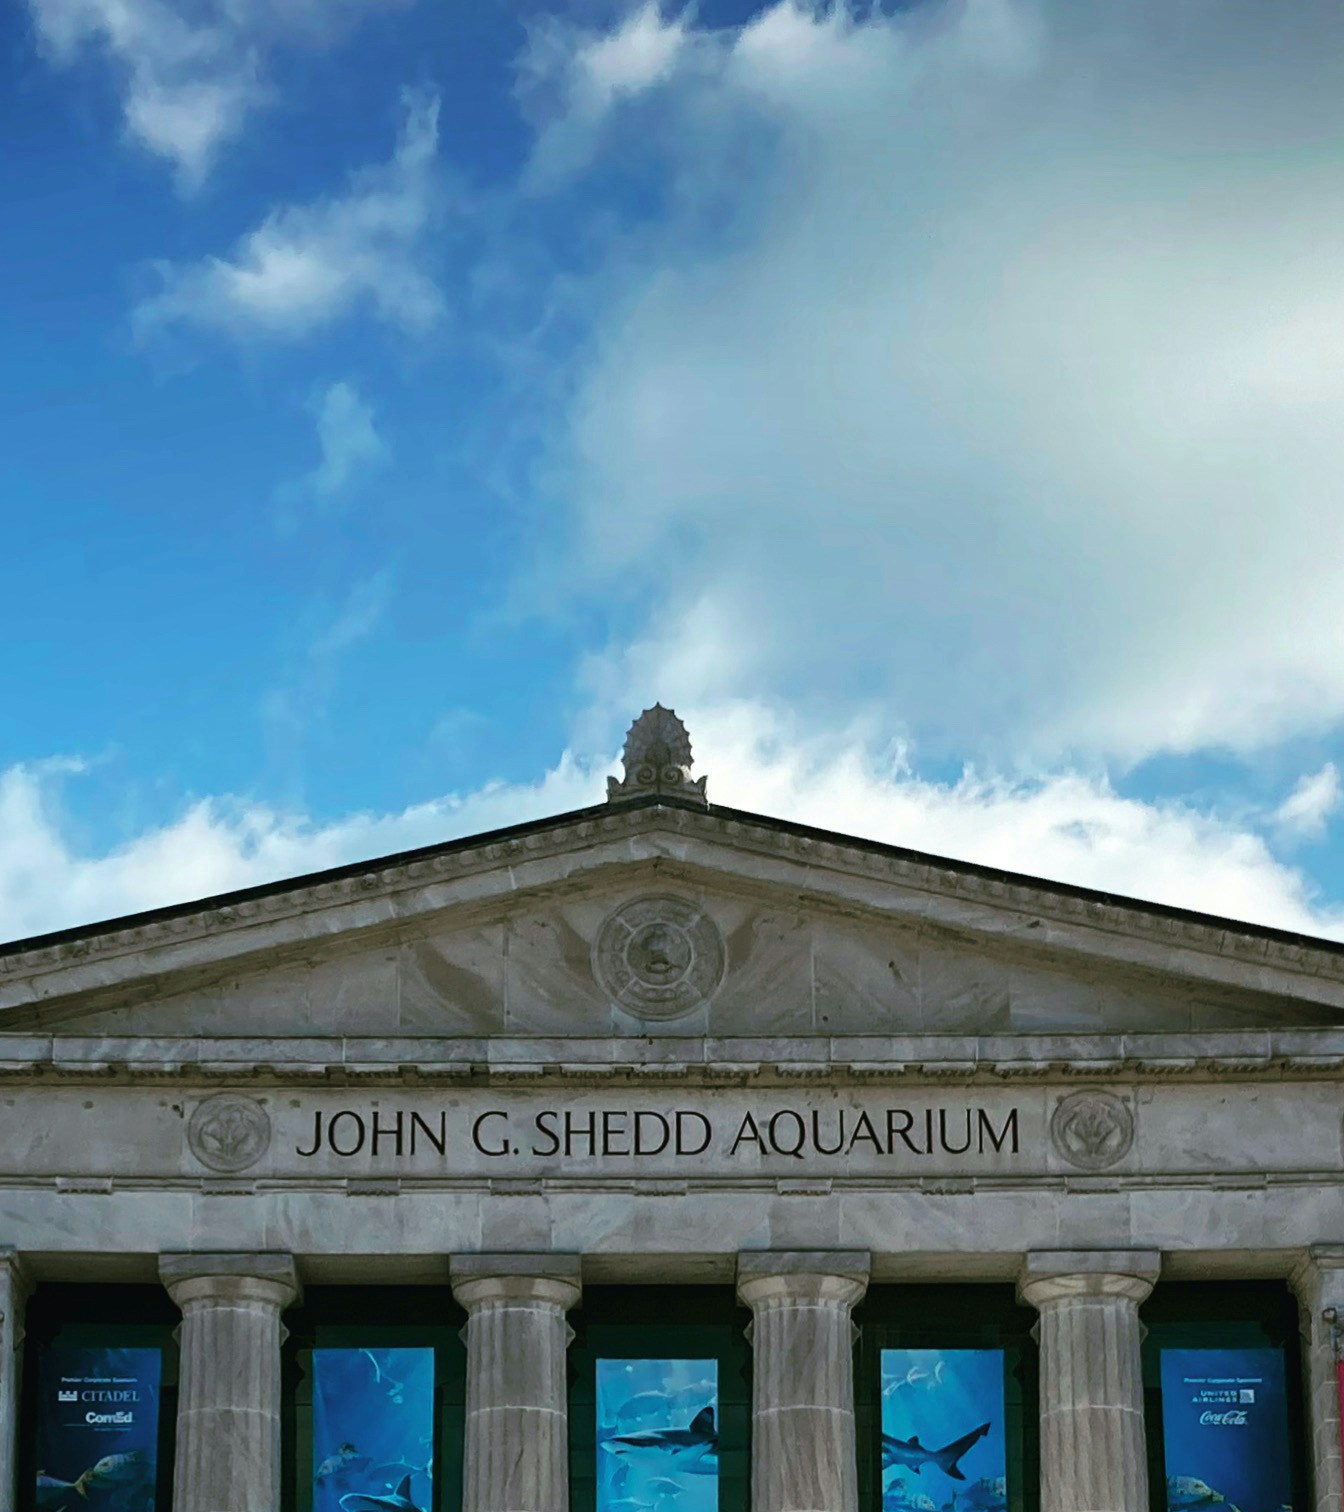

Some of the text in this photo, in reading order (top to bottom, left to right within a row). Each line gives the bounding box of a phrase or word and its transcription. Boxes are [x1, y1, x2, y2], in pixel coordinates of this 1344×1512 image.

[295, 1107, 1020, 1160] JOHN G. SHEDD AQUARIUM
[81, 1390, 140, 1402] CITADEL
[85, 1411, 133, 1424] ComEd
